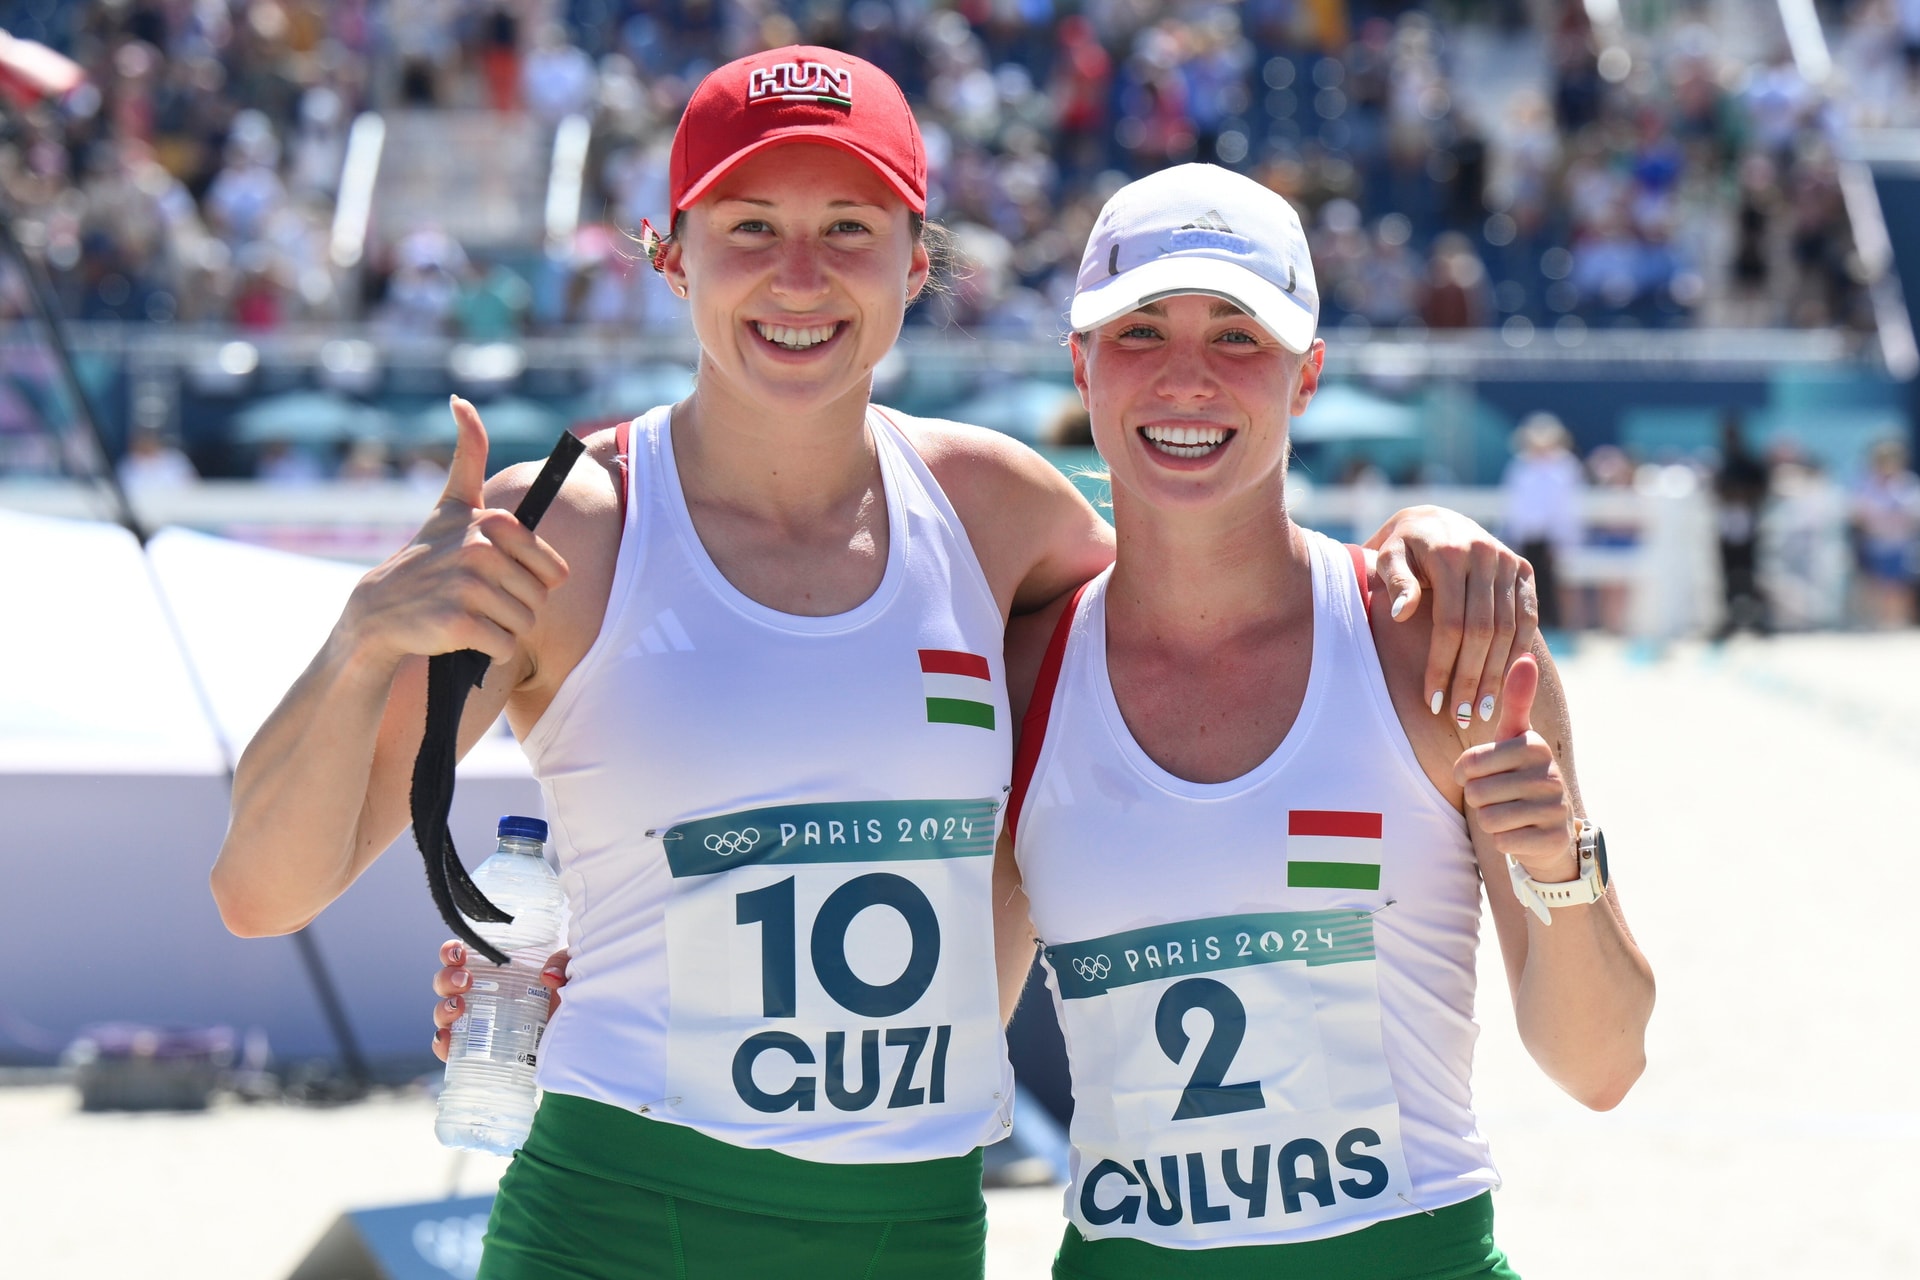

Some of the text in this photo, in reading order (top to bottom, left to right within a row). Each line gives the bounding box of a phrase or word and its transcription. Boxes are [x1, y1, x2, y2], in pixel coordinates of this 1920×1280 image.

[749, 62, 852, 98] HUN
[897, 816, 973, 842] 2024
[735, 872, 941, 1018] 10
[1235, 927, 1334, 957] 2024
[731, 1024, 952, 1113] GUZI
[1154, 977, 1266, 1121] 2
[1080, 1127, 1389, 1226] GULYAS
